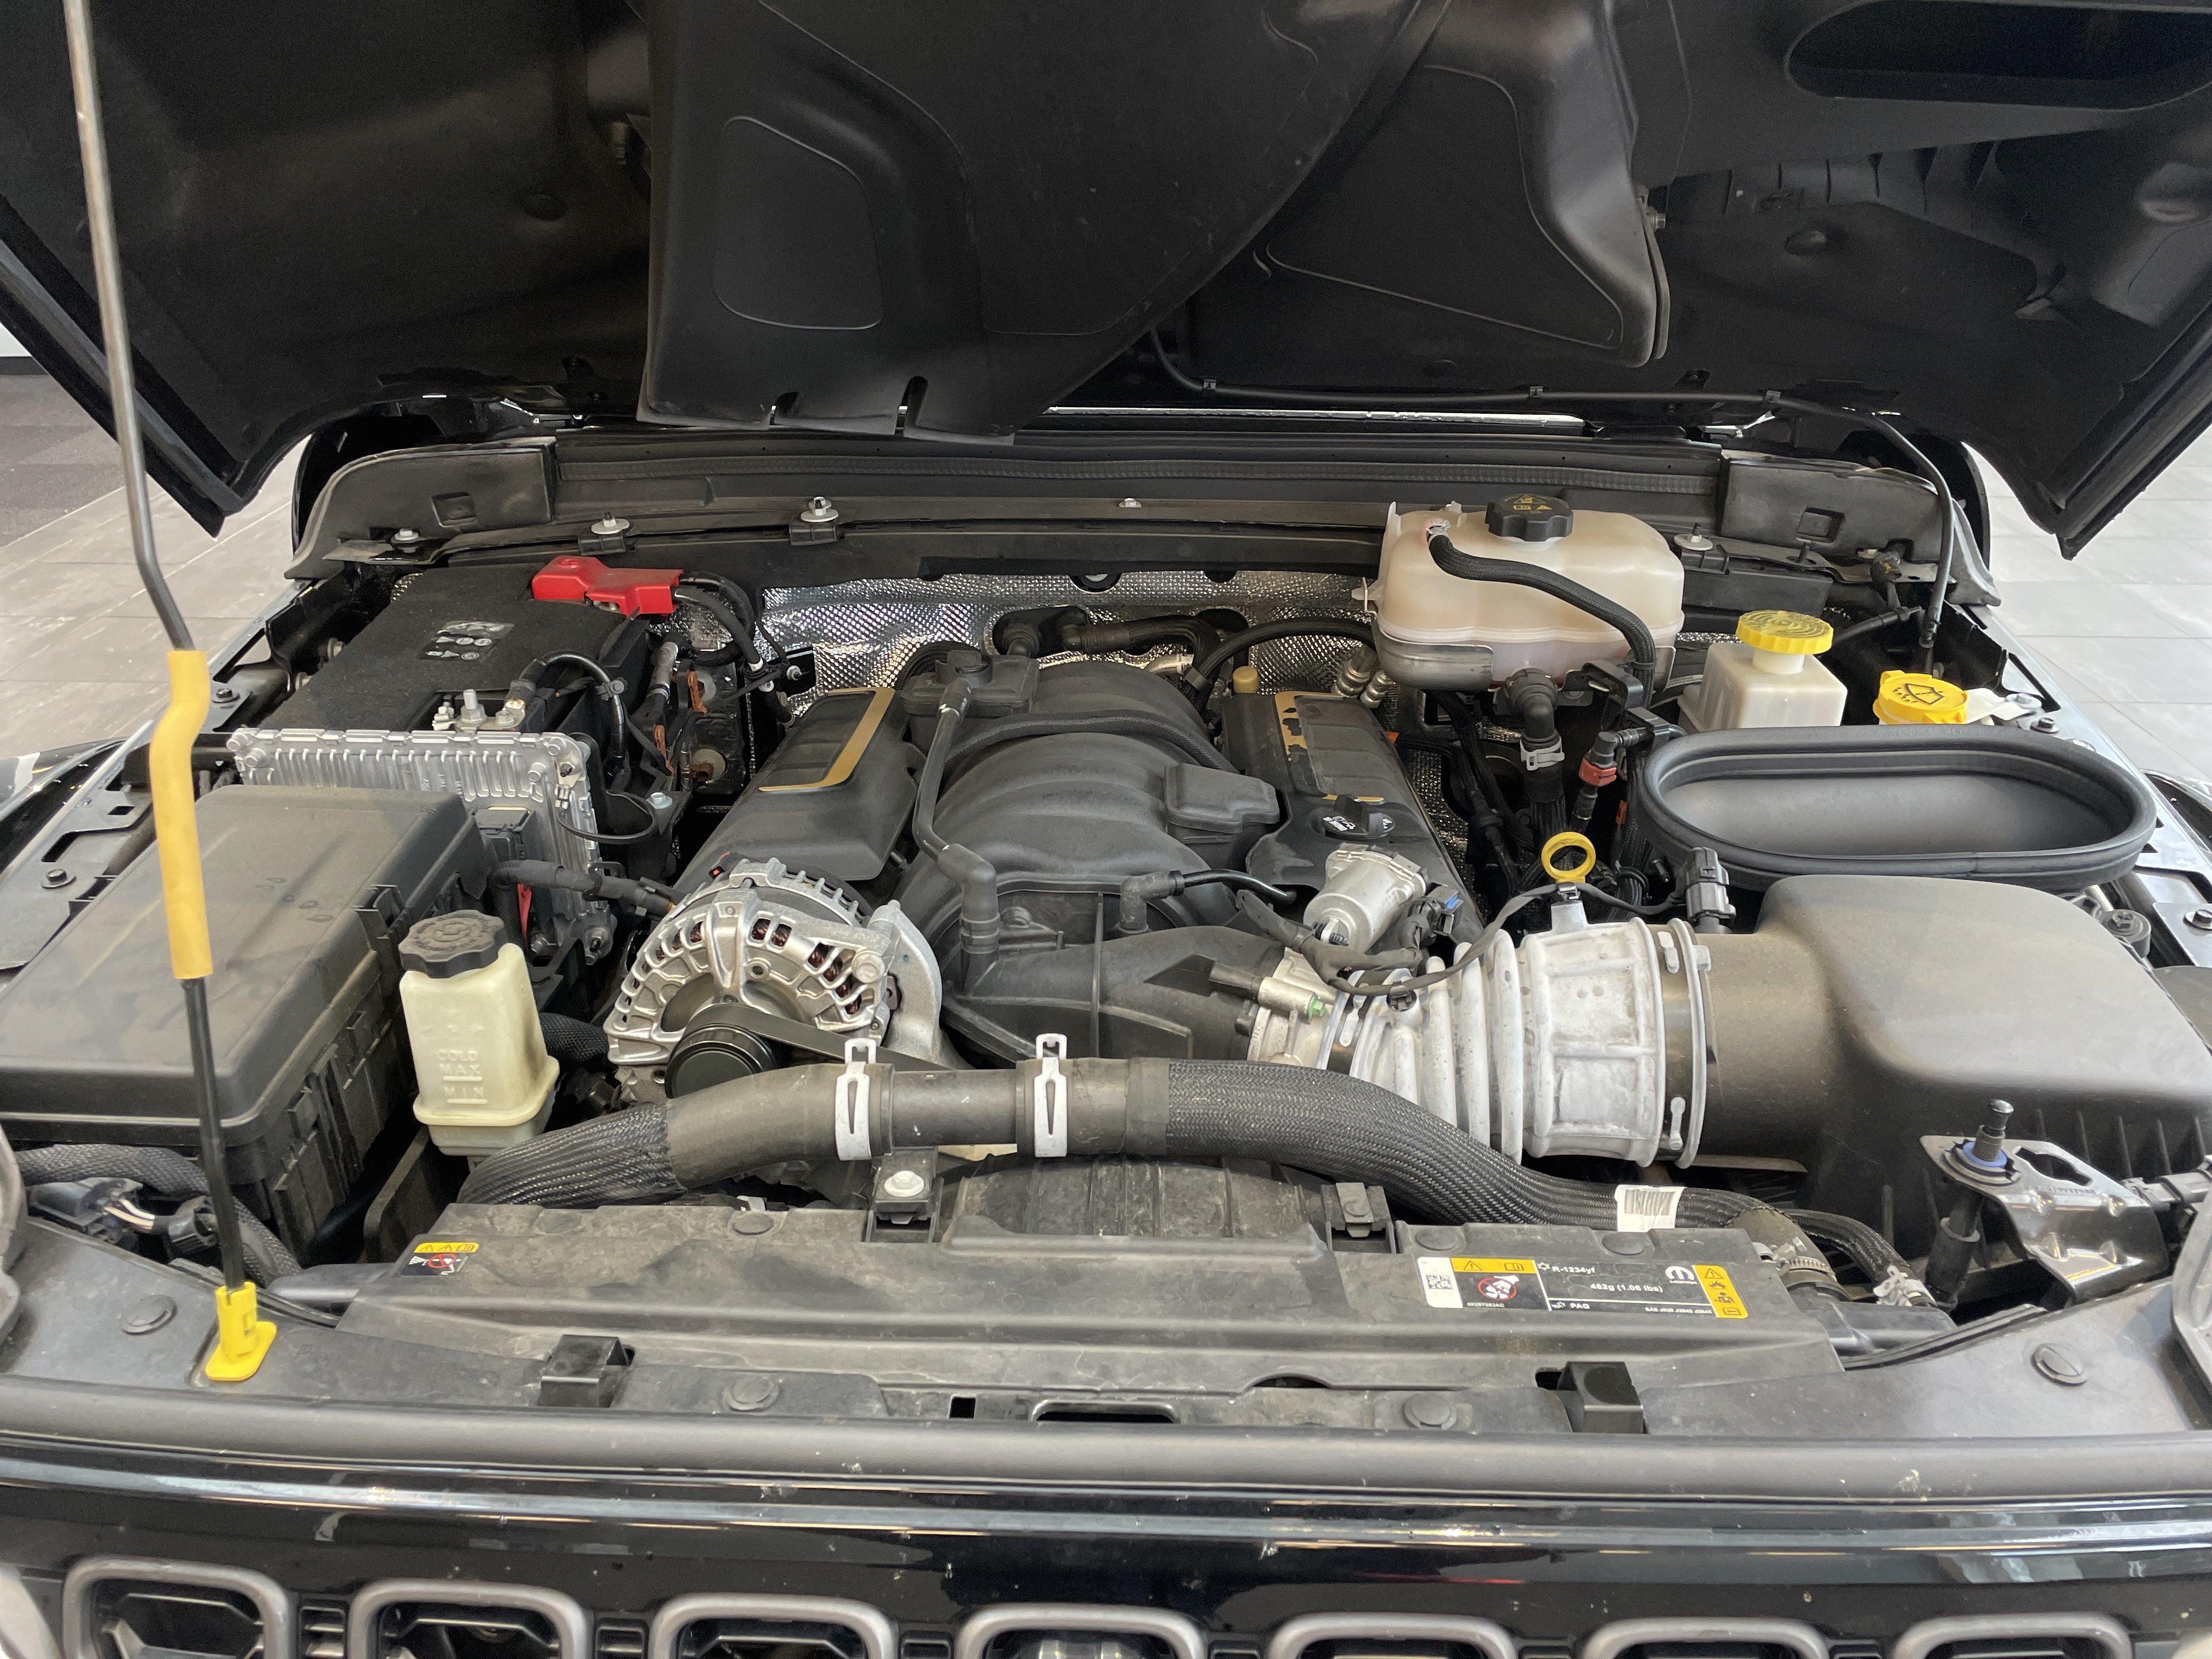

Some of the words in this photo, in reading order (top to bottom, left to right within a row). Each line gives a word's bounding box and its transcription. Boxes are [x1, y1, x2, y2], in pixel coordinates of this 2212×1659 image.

[437, 1049, 478, 1062] COLD
[439, 1064, 481, 1076] MAX
[443, 1086, 484, 1098] MIN
[1551, 1266, 1595, 1274] R-1234yf
[1617, 1284, 1642, 1292] (1.06
[1643, 1285, 1663, 1293] lbs)
